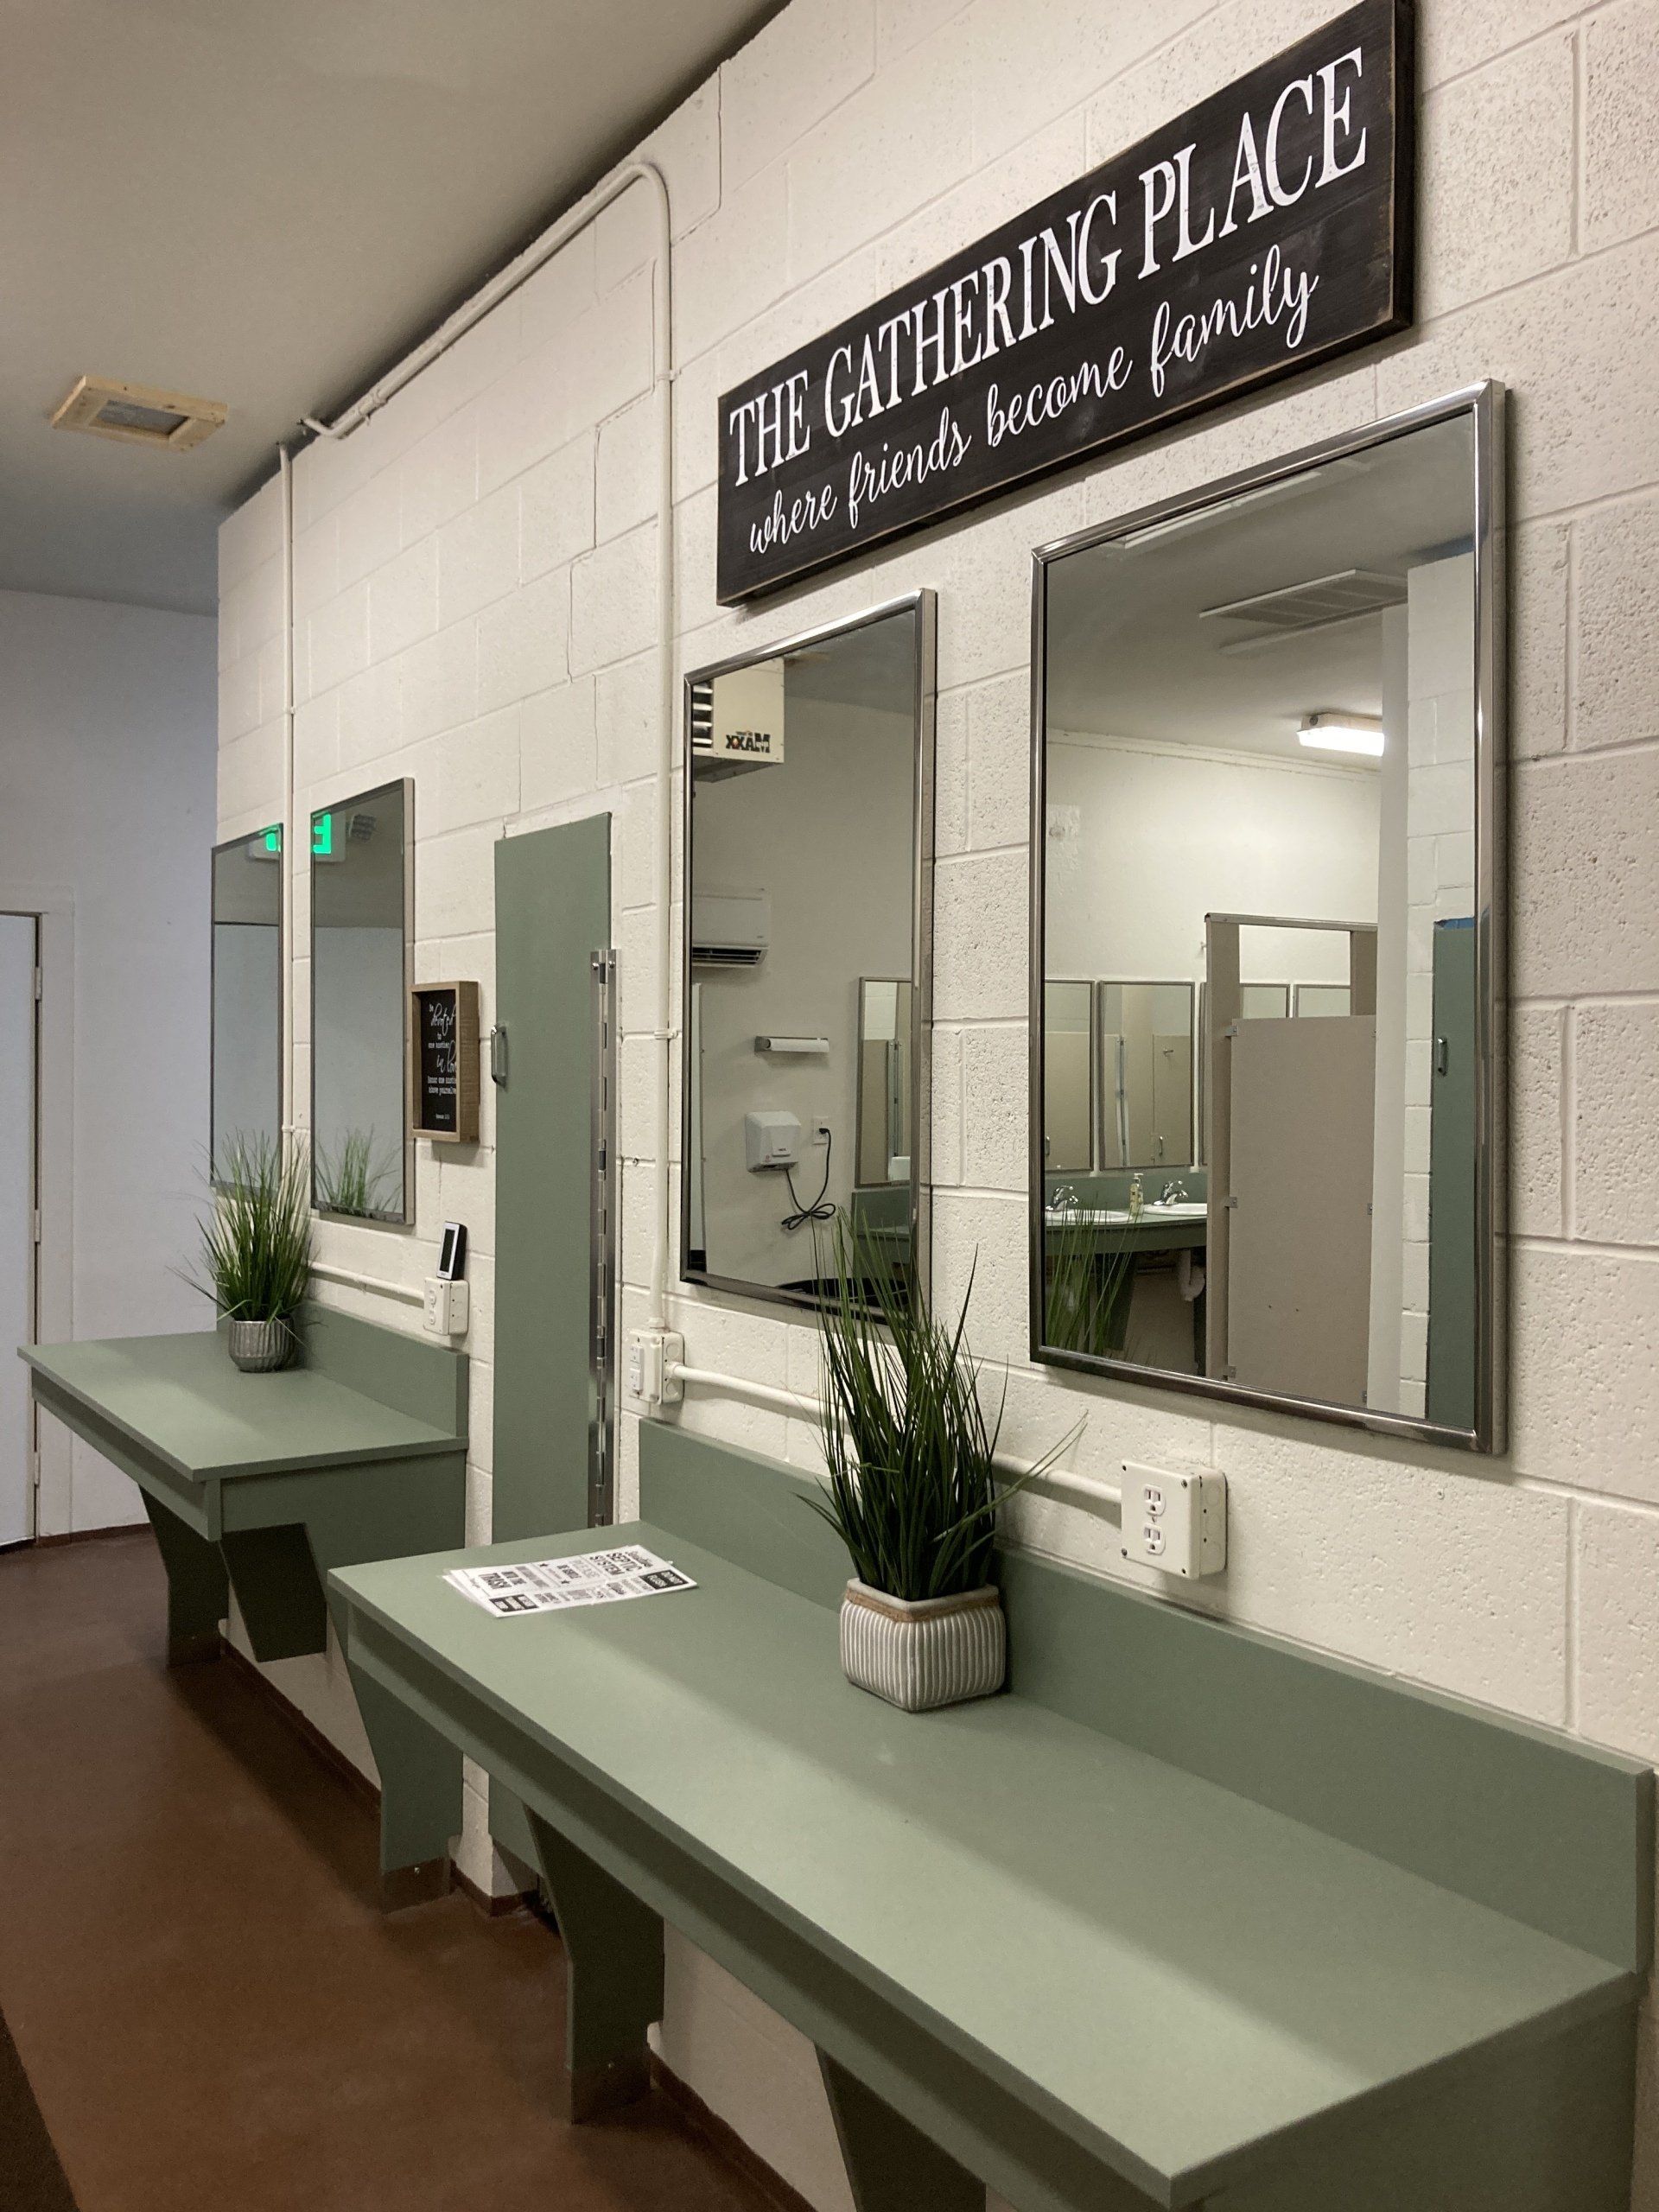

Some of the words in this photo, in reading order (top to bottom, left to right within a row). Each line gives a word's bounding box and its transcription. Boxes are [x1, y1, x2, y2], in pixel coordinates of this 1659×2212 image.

[729, 370, 810, 487] THE
[823, 189, 1122, 438] GATHERING
[1137, 47, 1367, 280] PLACE
[749, 484, 837, 554] where
[849, 406, 972, 529] friends
[987, 346, 1133, 447] become
[1150, 245, 1319, 397] family
[588, 1555, 626, 1575] SYSTEM
[605, 1552, 644, 1572] SEPTIC
